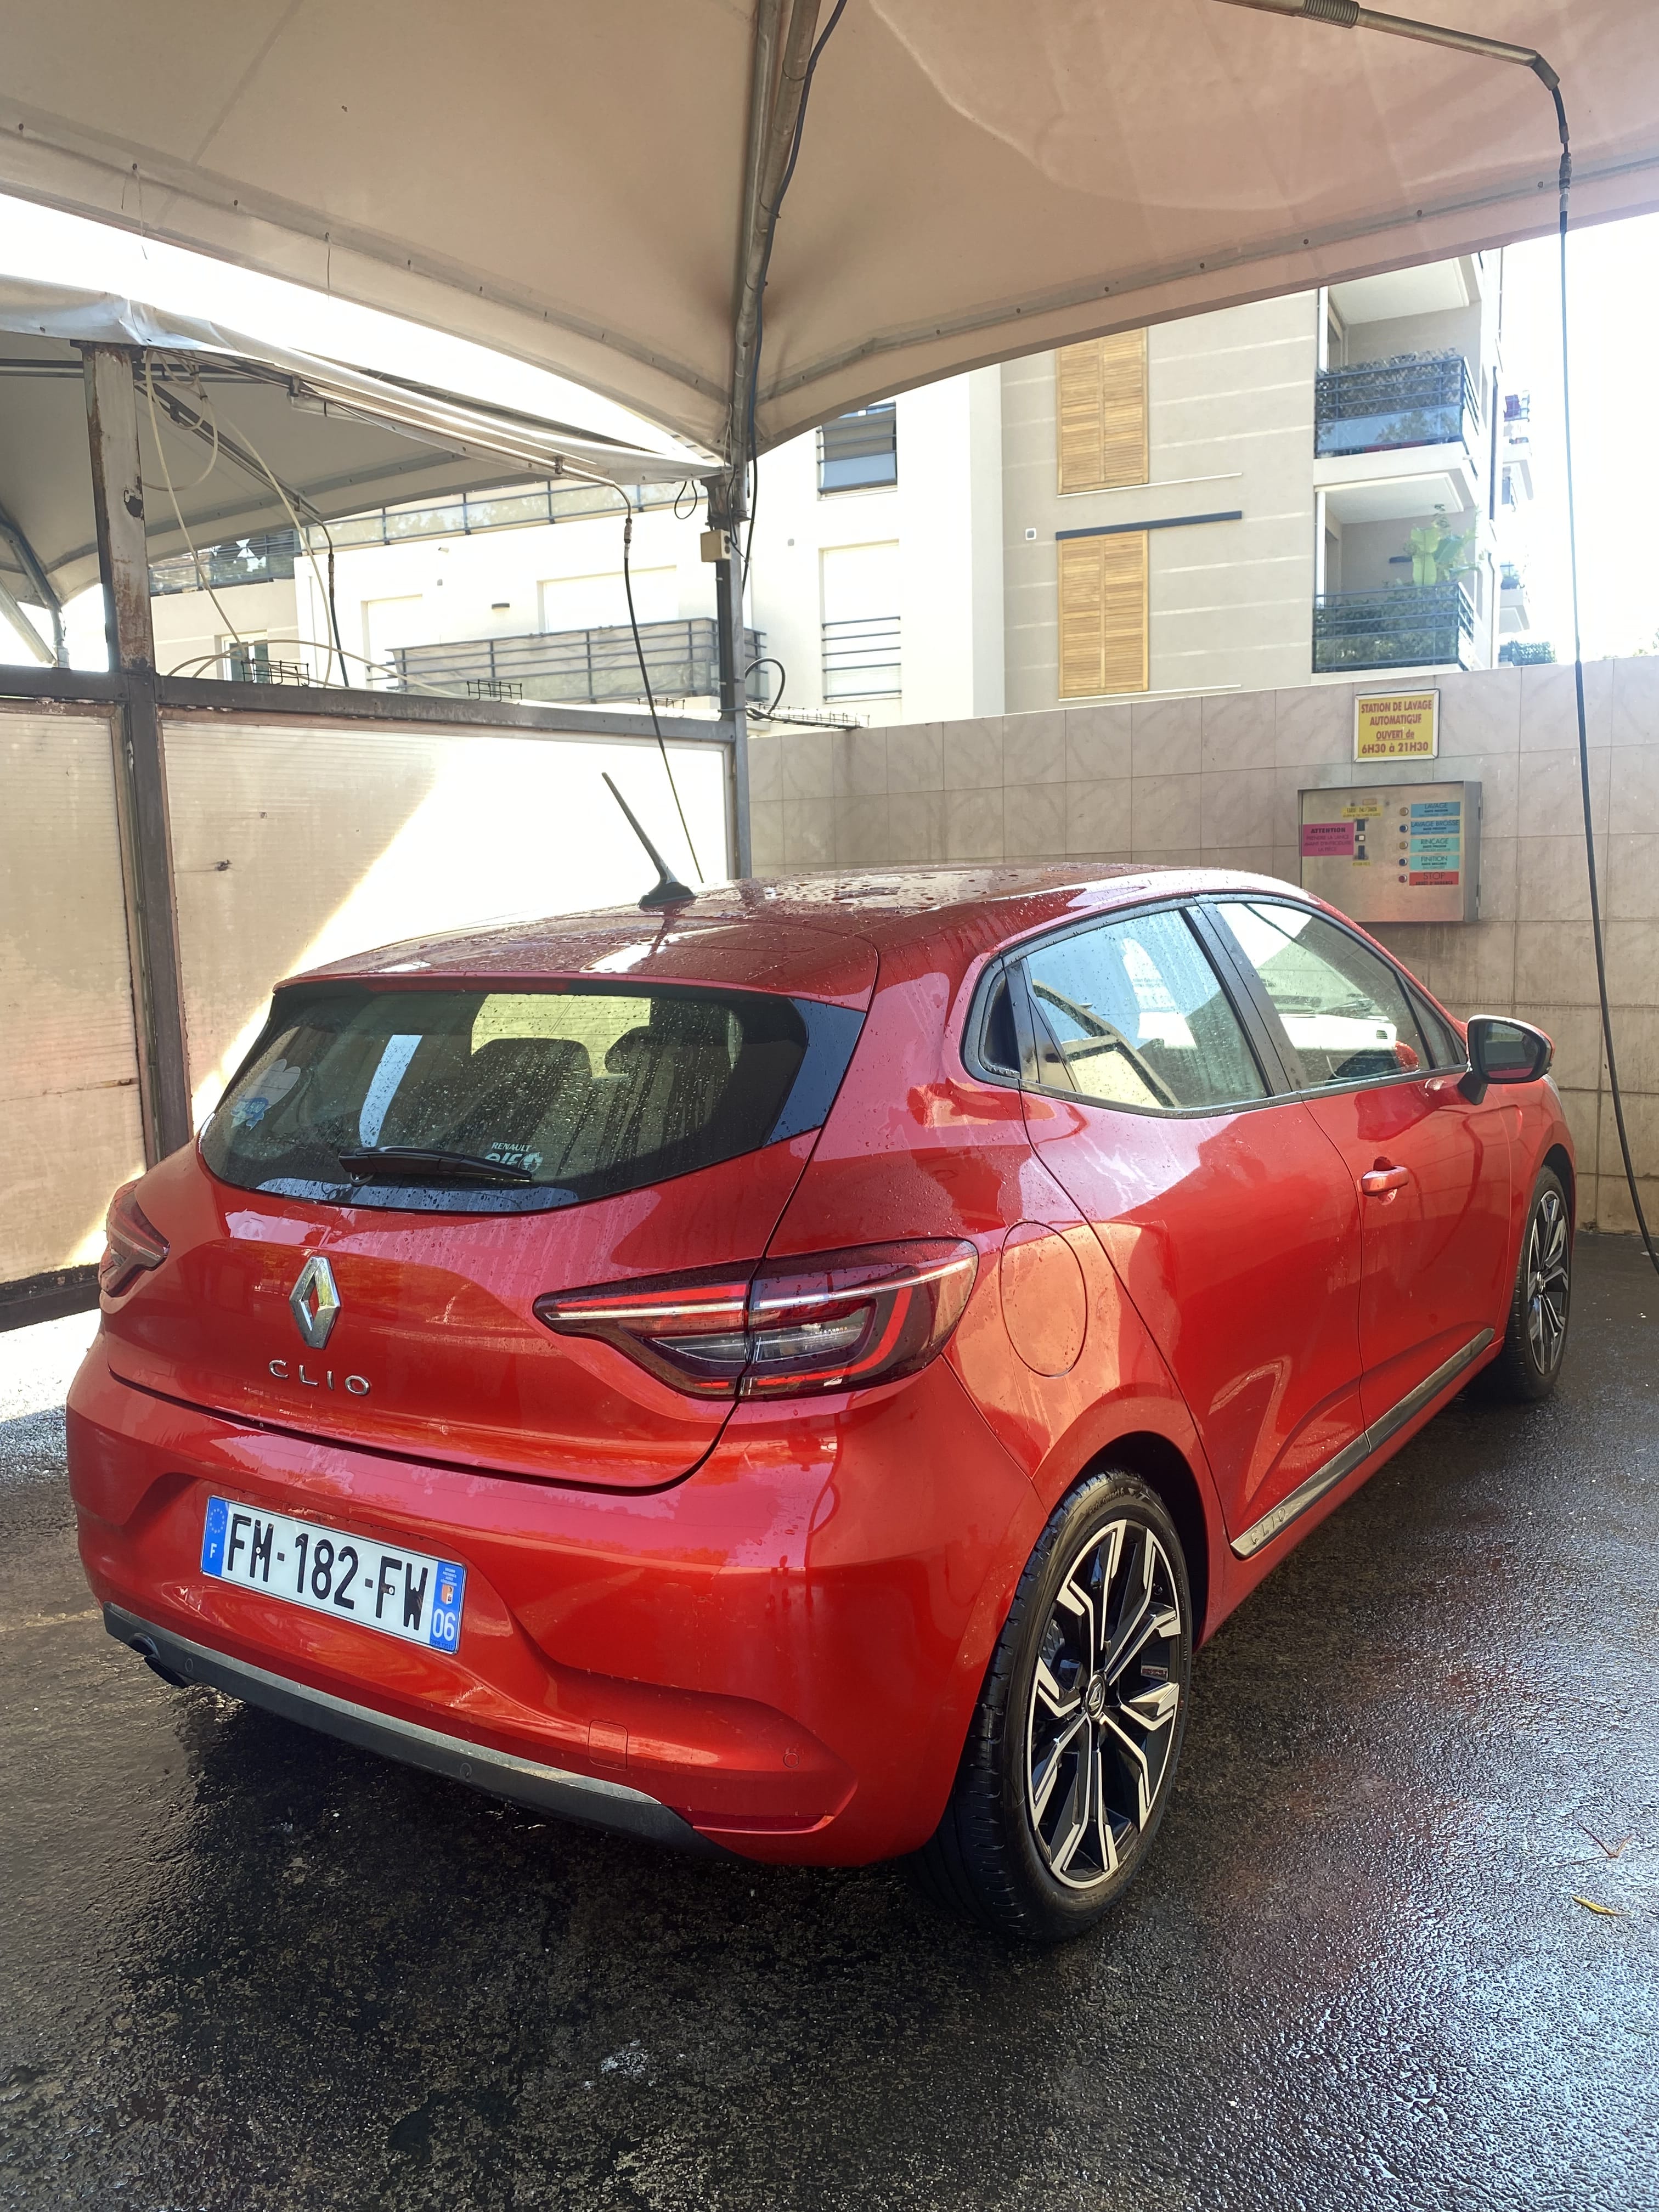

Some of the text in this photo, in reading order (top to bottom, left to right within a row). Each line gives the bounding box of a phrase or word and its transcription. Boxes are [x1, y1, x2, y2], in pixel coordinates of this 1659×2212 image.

[1361, 700, 1432, 713] STATION DE LAVAGE
[1370, 714, 1421, 726] AUTOMATIQUE
[1376, 729, 1414, 740] OUVERT de
[1362, 742, 1429, 754] 6H30 à 21H30
[1423, 871, 1446, 880] STOP
[491, 1142, 532, 1152] RENAULT
[268, 1359, 370, 1396] CLIO
[1251, 1508, 1286, 1545] CLIO
[210, 1543, 217, 1559] F
[227, 1513, 428, 1631] FM-182-FW
[432, 1608, 456, 1641] 06
